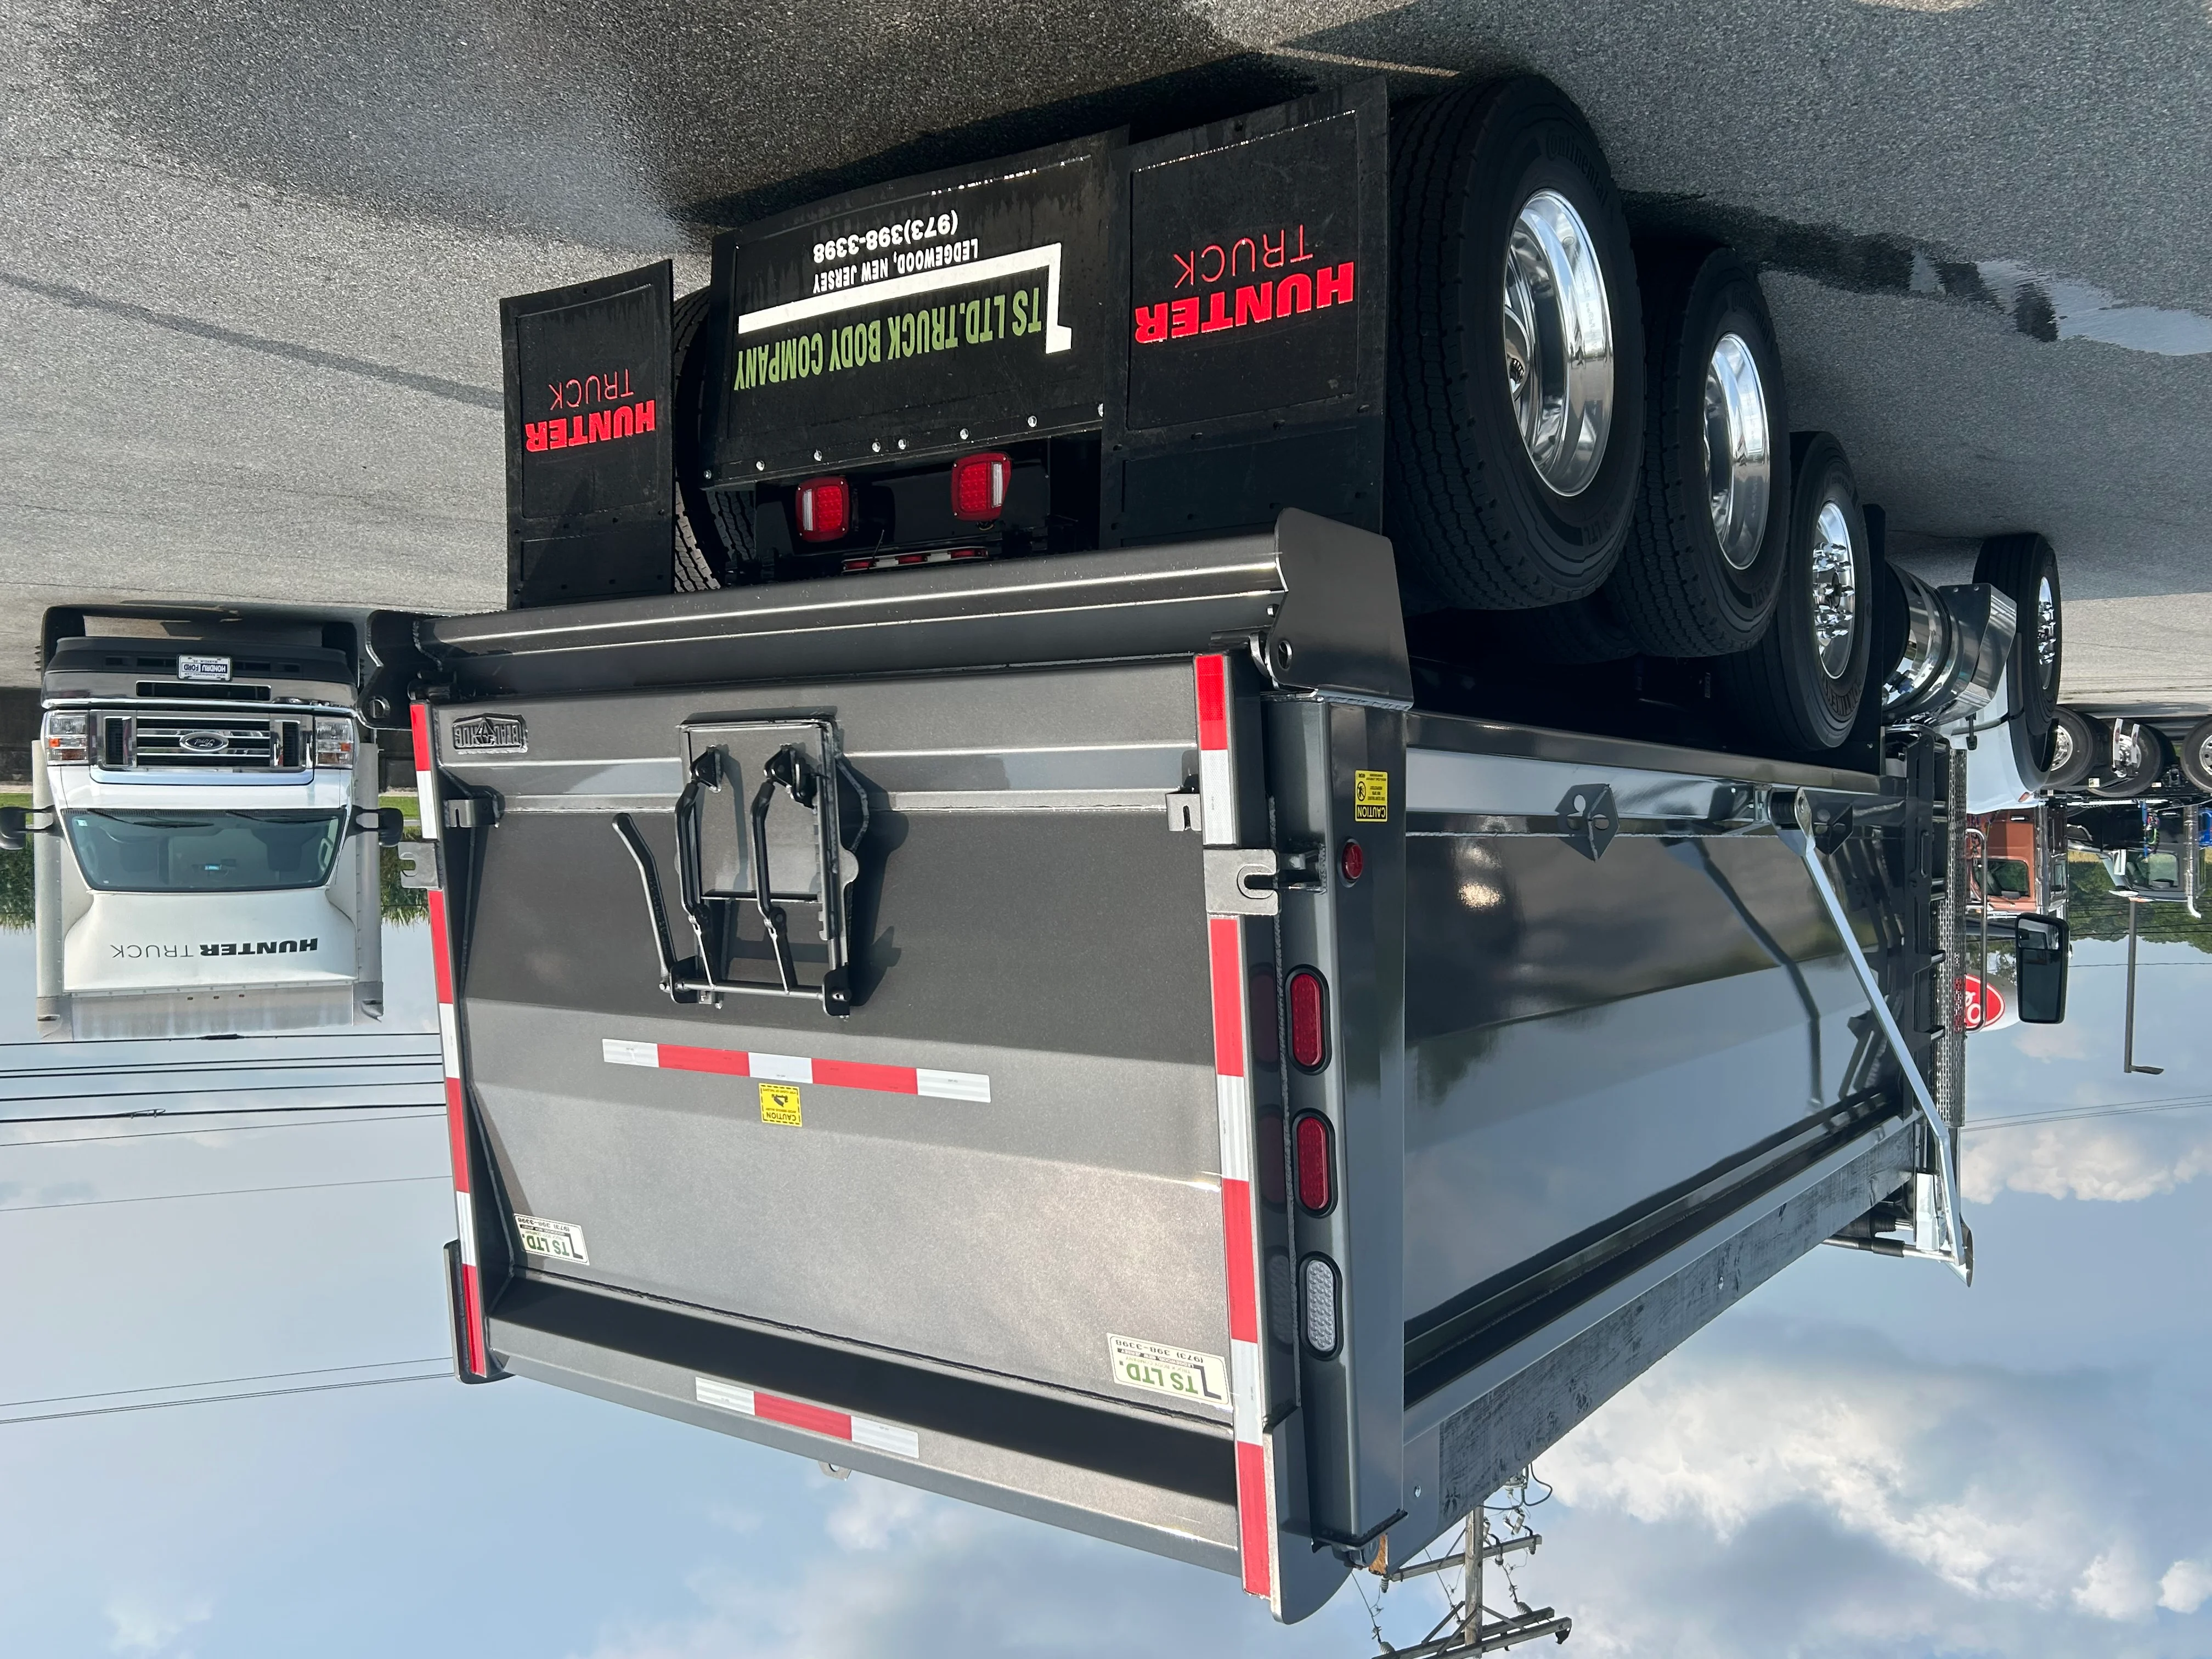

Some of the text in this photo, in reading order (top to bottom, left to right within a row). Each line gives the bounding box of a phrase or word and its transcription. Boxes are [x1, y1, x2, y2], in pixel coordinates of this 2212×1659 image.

[1545, 128, 1609, 208] Continental
[812, 210, 958, 264] (973)398-3398
[1172, 224, 1313, 289] TRUCK
[812, 238, 979, 294] LEDGEWOOD, NEW JERSEY
[1012, 287, 1041, 337] TS
[1133, 261, 1355, 345] HUNTER
[733, 331, 823, 391] COMPANY
[828, 319, 881, 371] BODY
[548, 369, 634, 410] TRUCK
[524, 399, 656, 452] HUNTER
[202, 664, 226, 673] HONDRU
[194, 738, 216, 747] Ford
[1357, 806, 1386, 819] CAUTION
[110, 938, 318, 959] HUNTER TRUCK
[766, 1111, 797, 1121] CAUTION
[522, 1234, 569, 1256] TS LTD.
[1115, 1339, 1203, 1363] (973) 398-3398
[1119, 1360, 1198, 1395] TS LTD.
